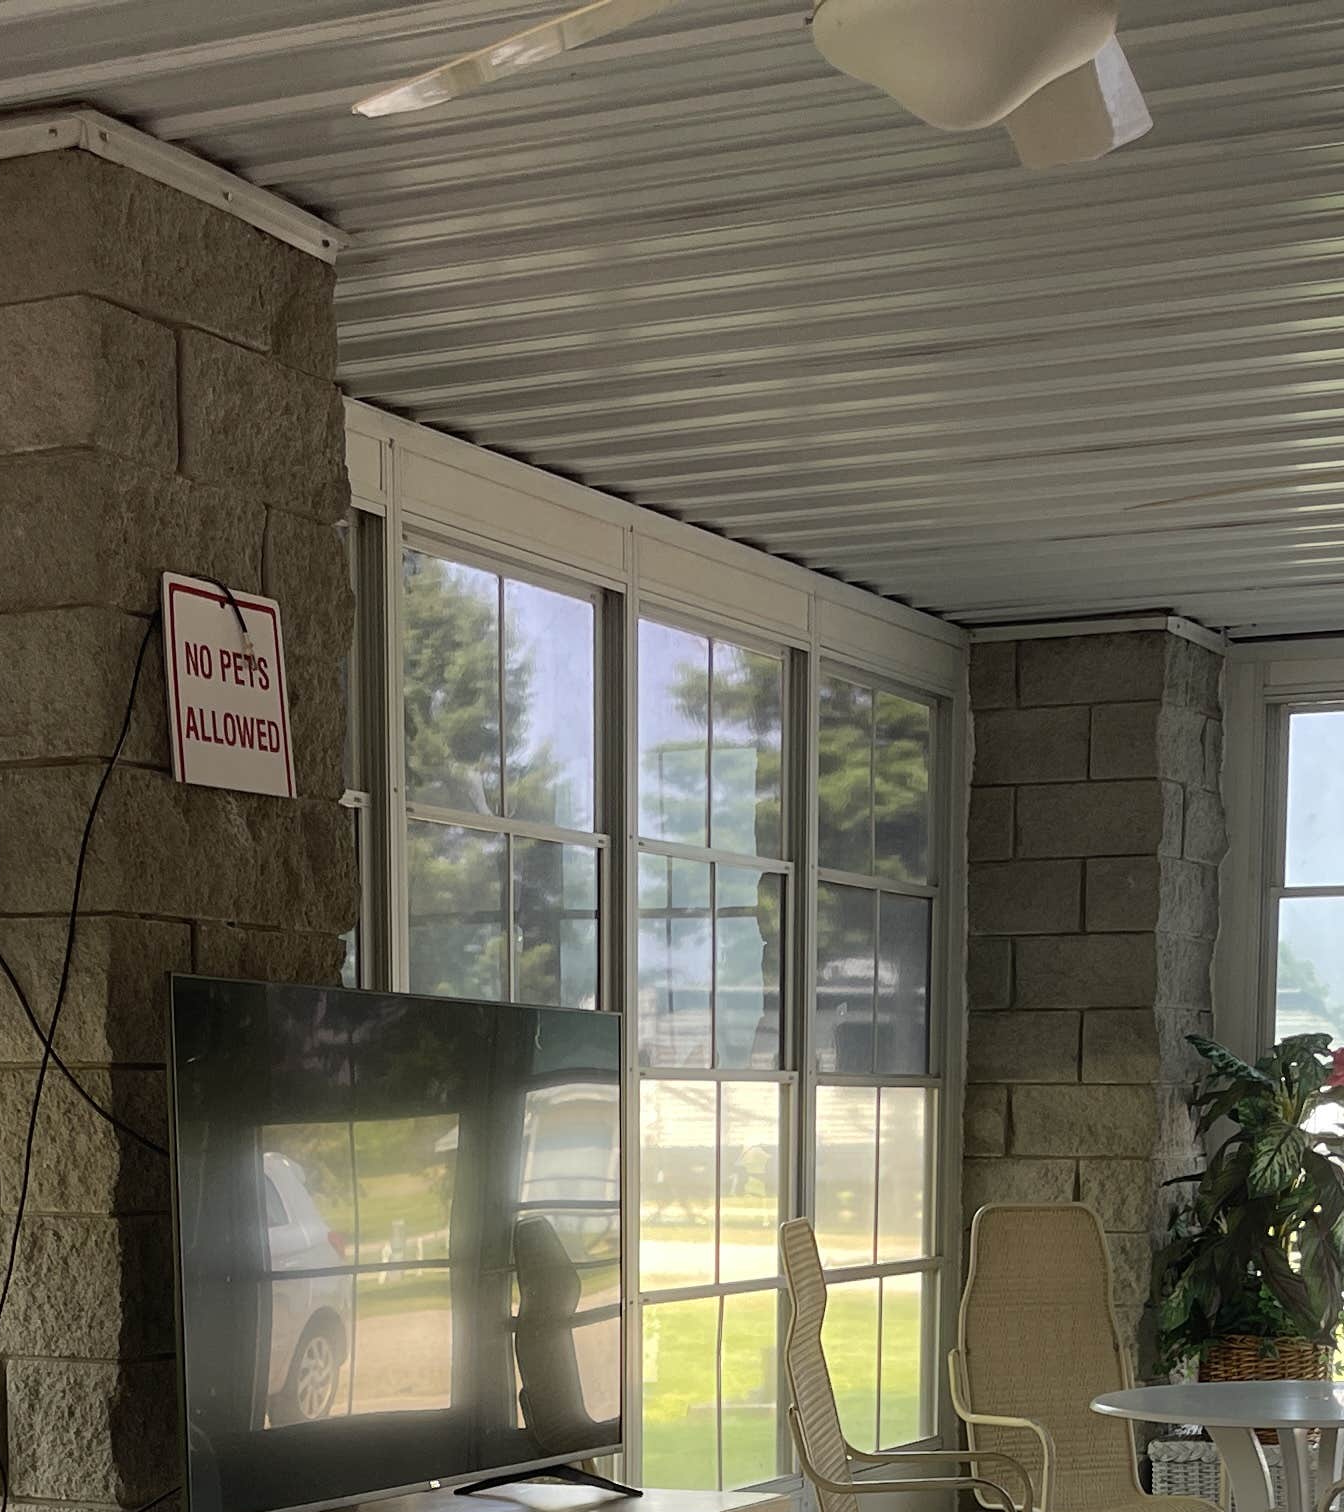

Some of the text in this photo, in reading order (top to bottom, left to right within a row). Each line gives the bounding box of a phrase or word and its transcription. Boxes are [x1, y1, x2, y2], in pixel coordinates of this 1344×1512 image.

[184, 641, 270, 691] NO PETS
[185, 706, 281, 753] ALLOWED
